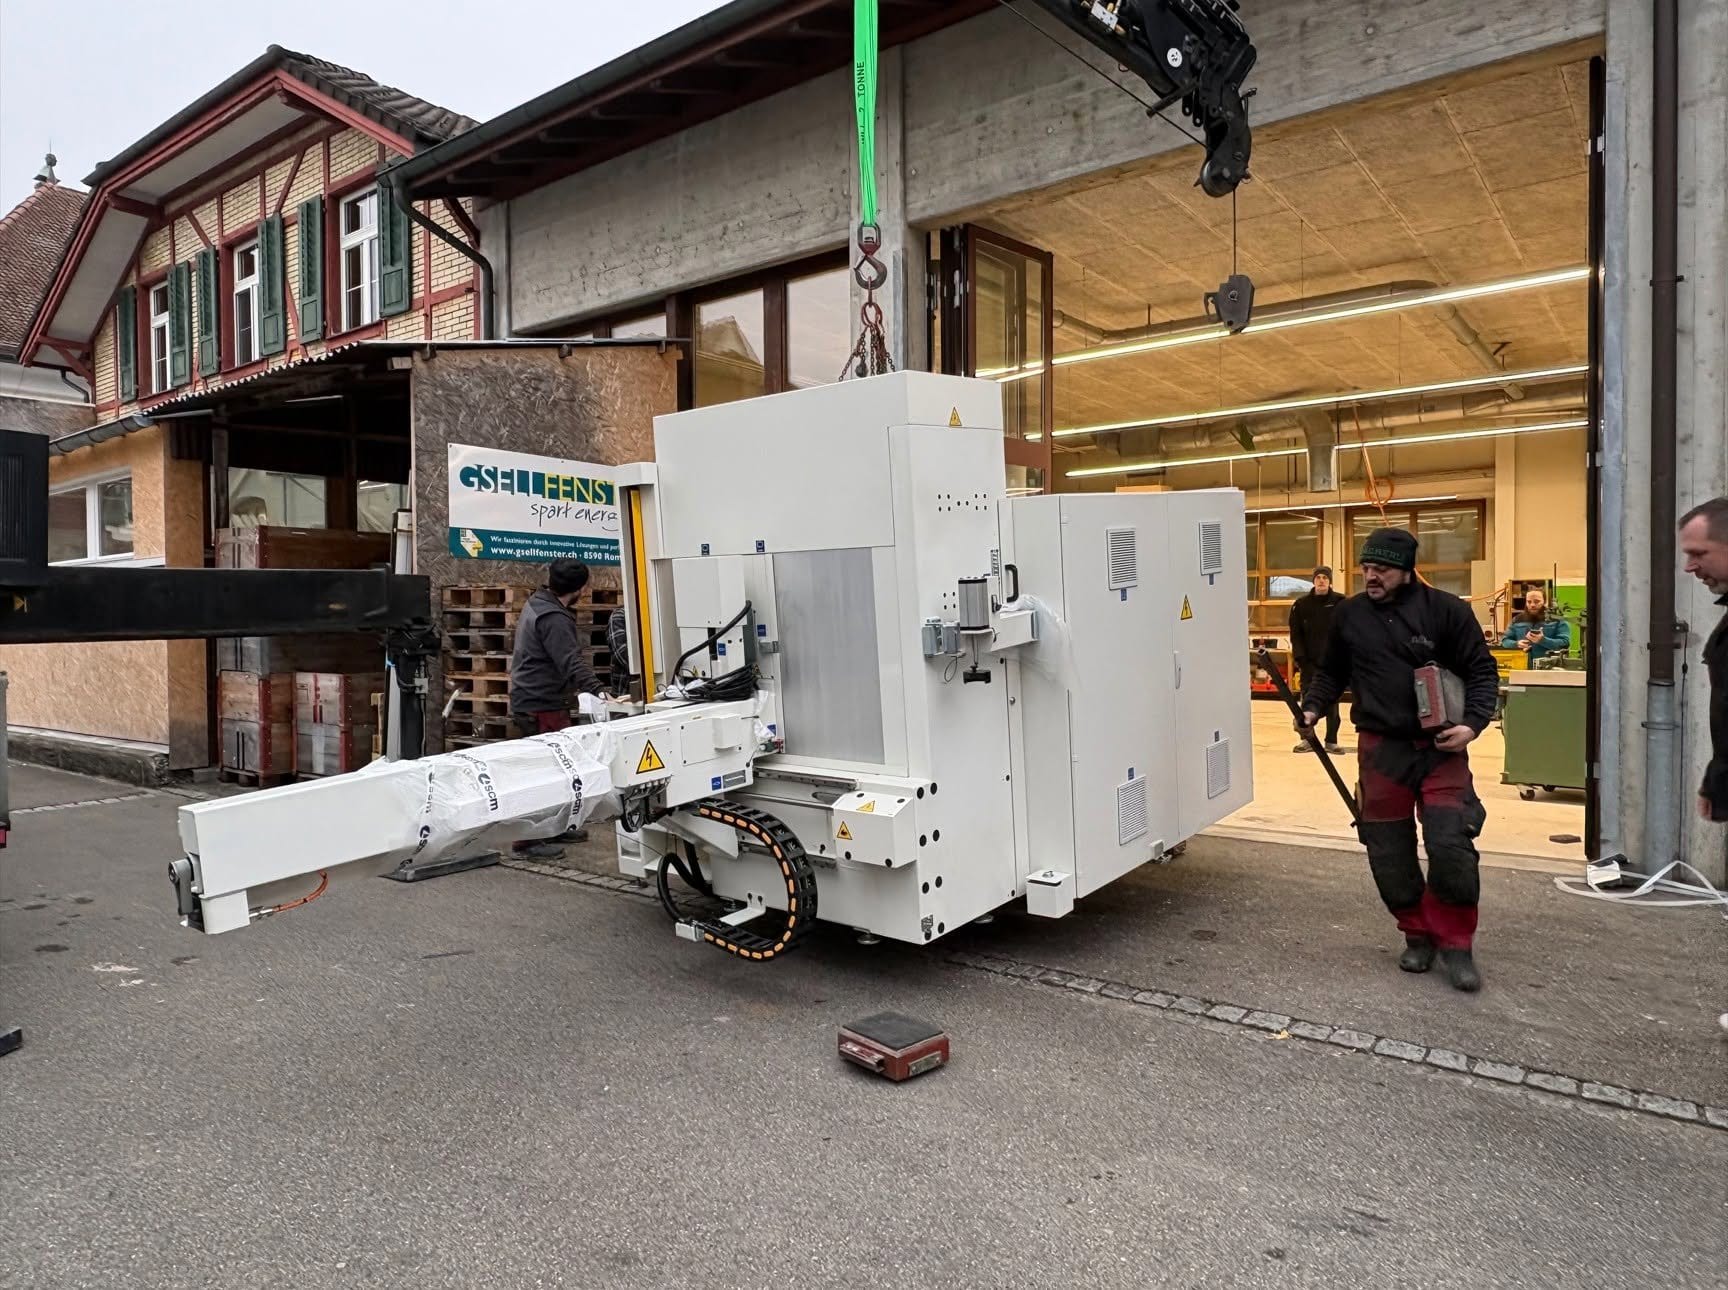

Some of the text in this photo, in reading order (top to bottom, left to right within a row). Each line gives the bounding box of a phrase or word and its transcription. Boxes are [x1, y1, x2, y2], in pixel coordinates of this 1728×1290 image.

[857, 61, 865, 97] TONNE
[530, 502, 572, 527] spart
[491, 547, 577, 558] www.gsellfenster.ch
[583, 551, 602, 560] 8590
[504, 537, 532, 545] faszinieren
[576, 542, 598, 550] Lösungen
[556, 748, 573, 770] scm
[484, 785, 499, 811] scm
[573, 791, 582, 815] scm
